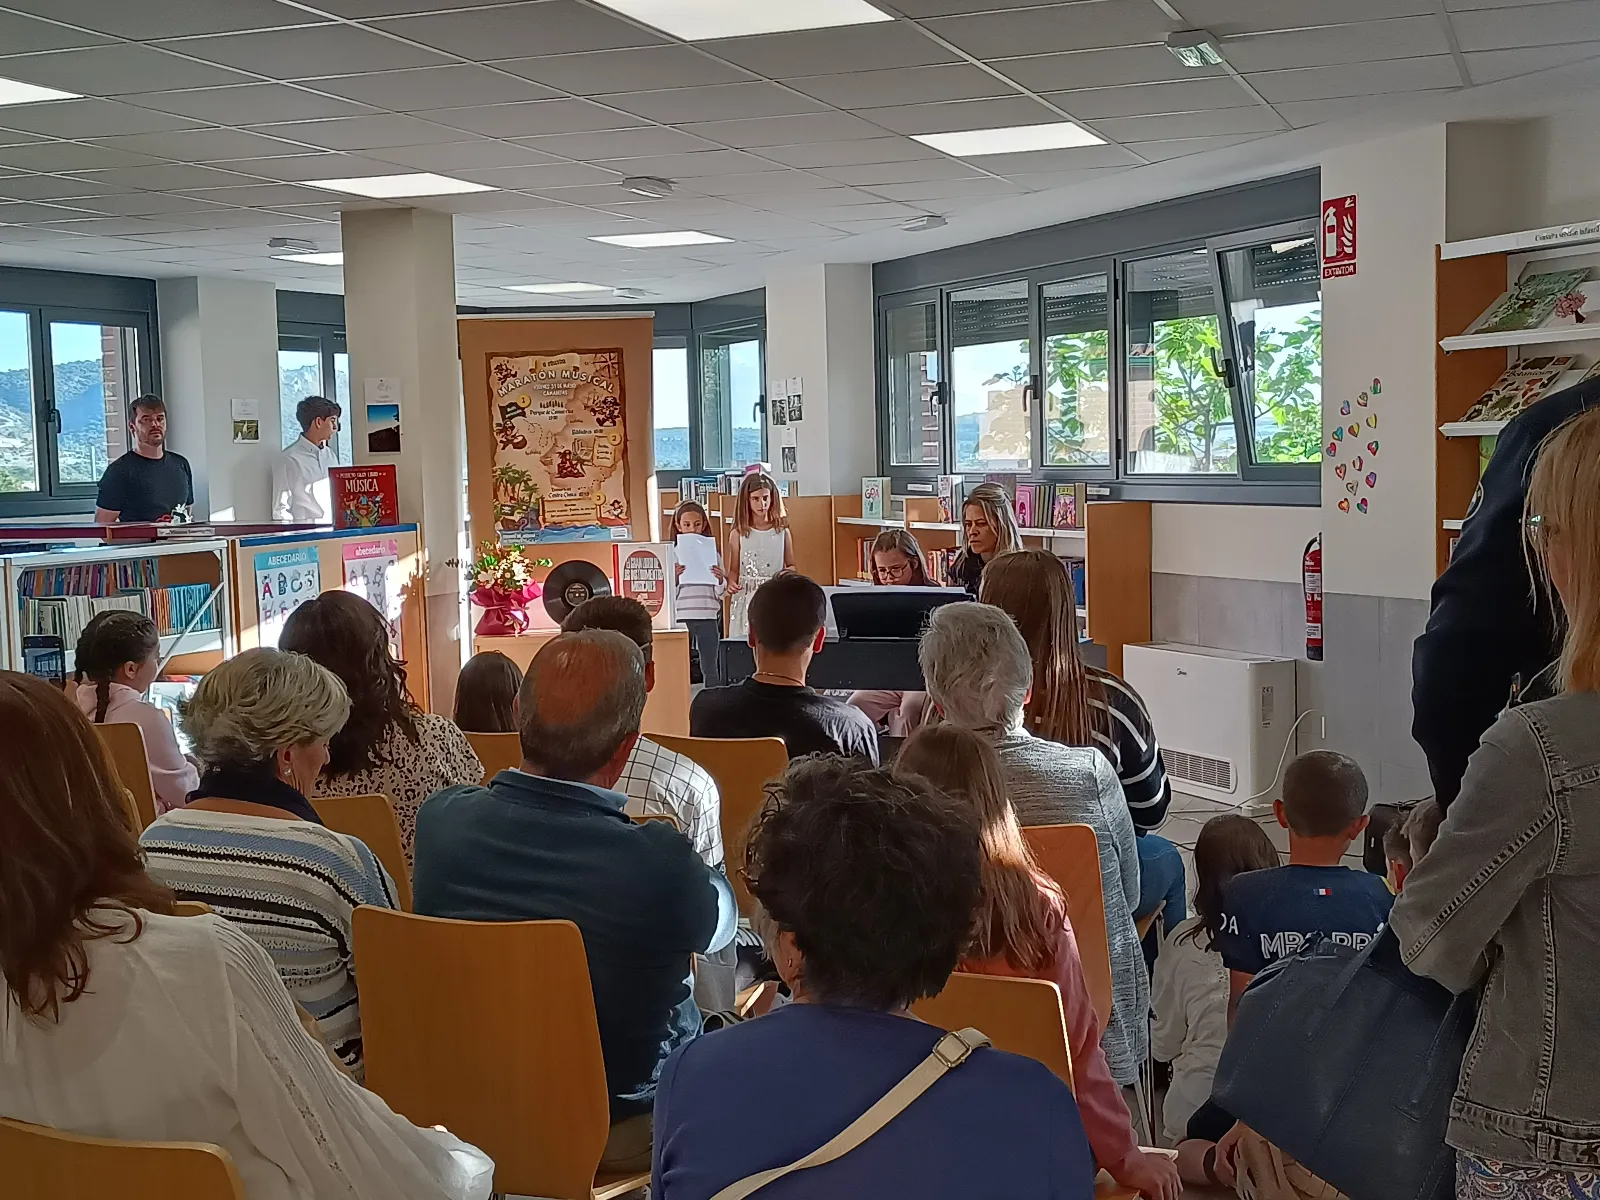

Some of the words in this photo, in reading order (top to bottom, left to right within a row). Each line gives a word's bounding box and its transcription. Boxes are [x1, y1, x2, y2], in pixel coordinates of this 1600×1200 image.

[1324, 265, 1354, 277] EXTINTOR
[498, 369, 556, 397] MARATÓN
[561, 370, 614, 393] MUSICAL
[345, 478, 379, 493] MÚSICA
[355, 545, 385, 556] abecedario
[268, 553, 306, 566] ABECEDARIO
